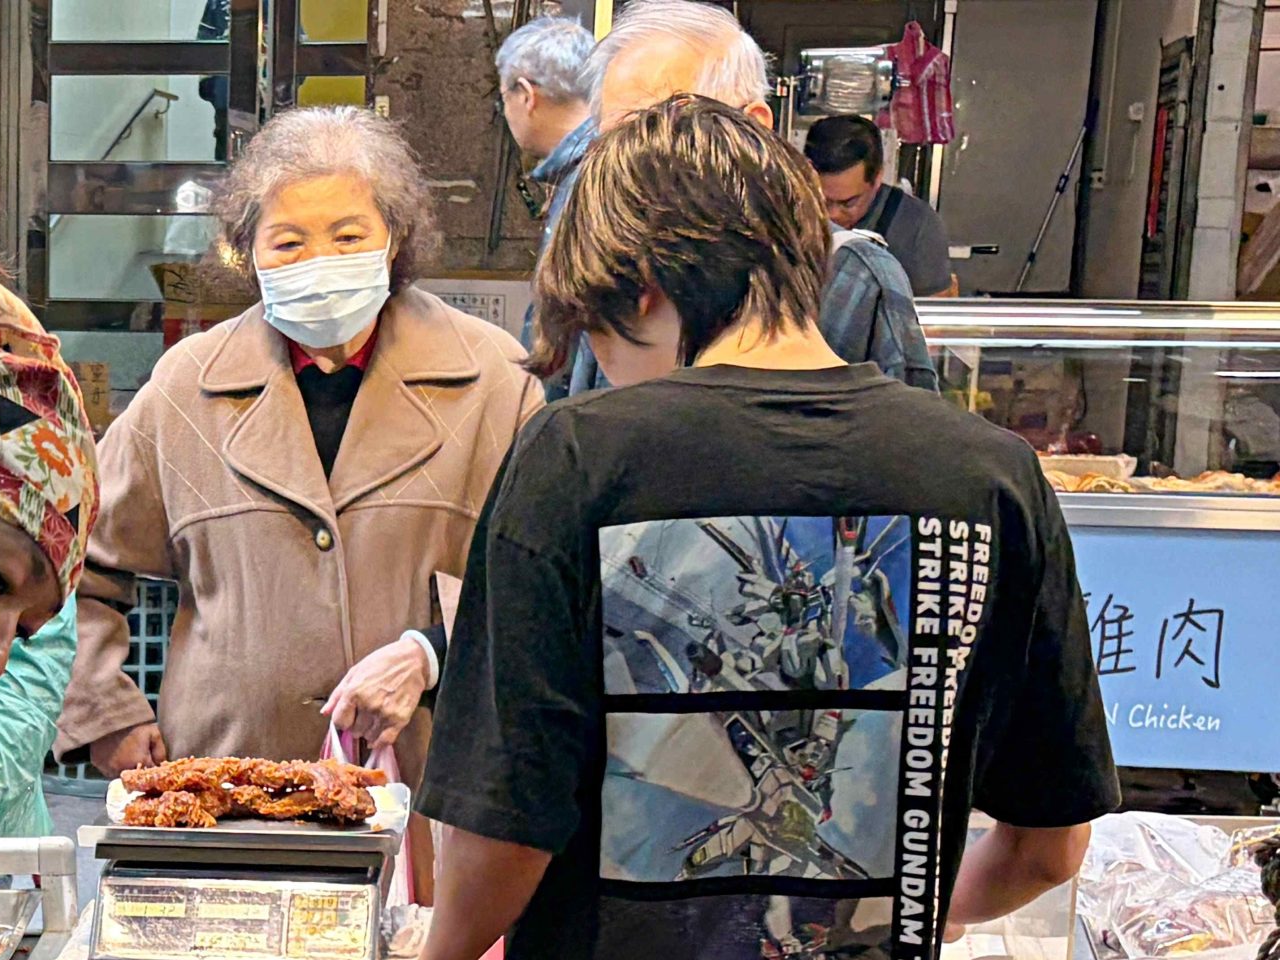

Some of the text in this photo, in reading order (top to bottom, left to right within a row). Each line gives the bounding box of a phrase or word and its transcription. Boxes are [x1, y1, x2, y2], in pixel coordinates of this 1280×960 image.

[915, 516, 942, 635] STRIKE
[947, 519, 969, 637] STRIKE
[904, 647, 939, 797] FREEDOM
[1128, 703, 1221, 731] Chicken
[899, 809, 931, 945] GUNDAM
